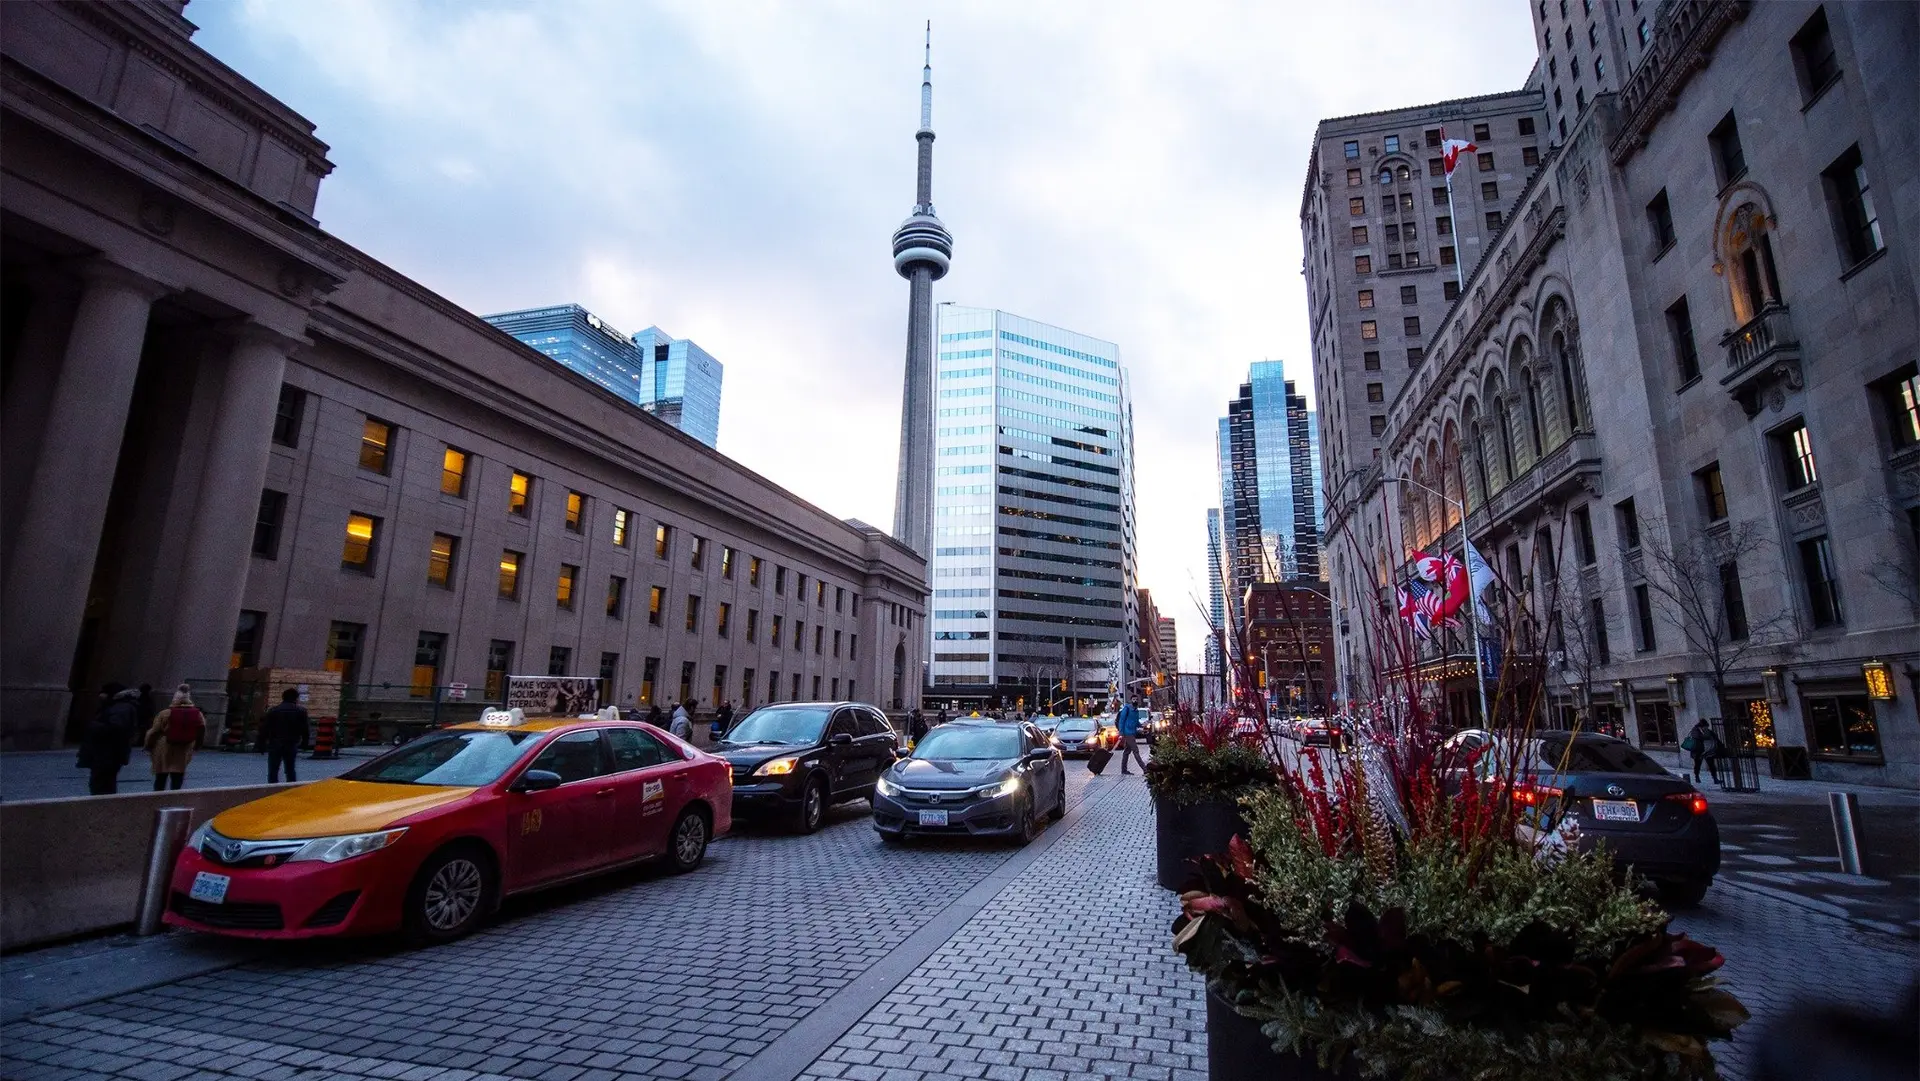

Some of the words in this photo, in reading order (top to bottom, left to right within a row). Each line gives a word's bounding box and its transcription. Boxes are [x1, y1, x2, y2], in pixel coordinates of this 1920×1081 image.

[510, 681, 534, 689] MAKE
[536, 681, 557, 689] YOUR
[509, 690, 548, 698] HOLIDAYS
